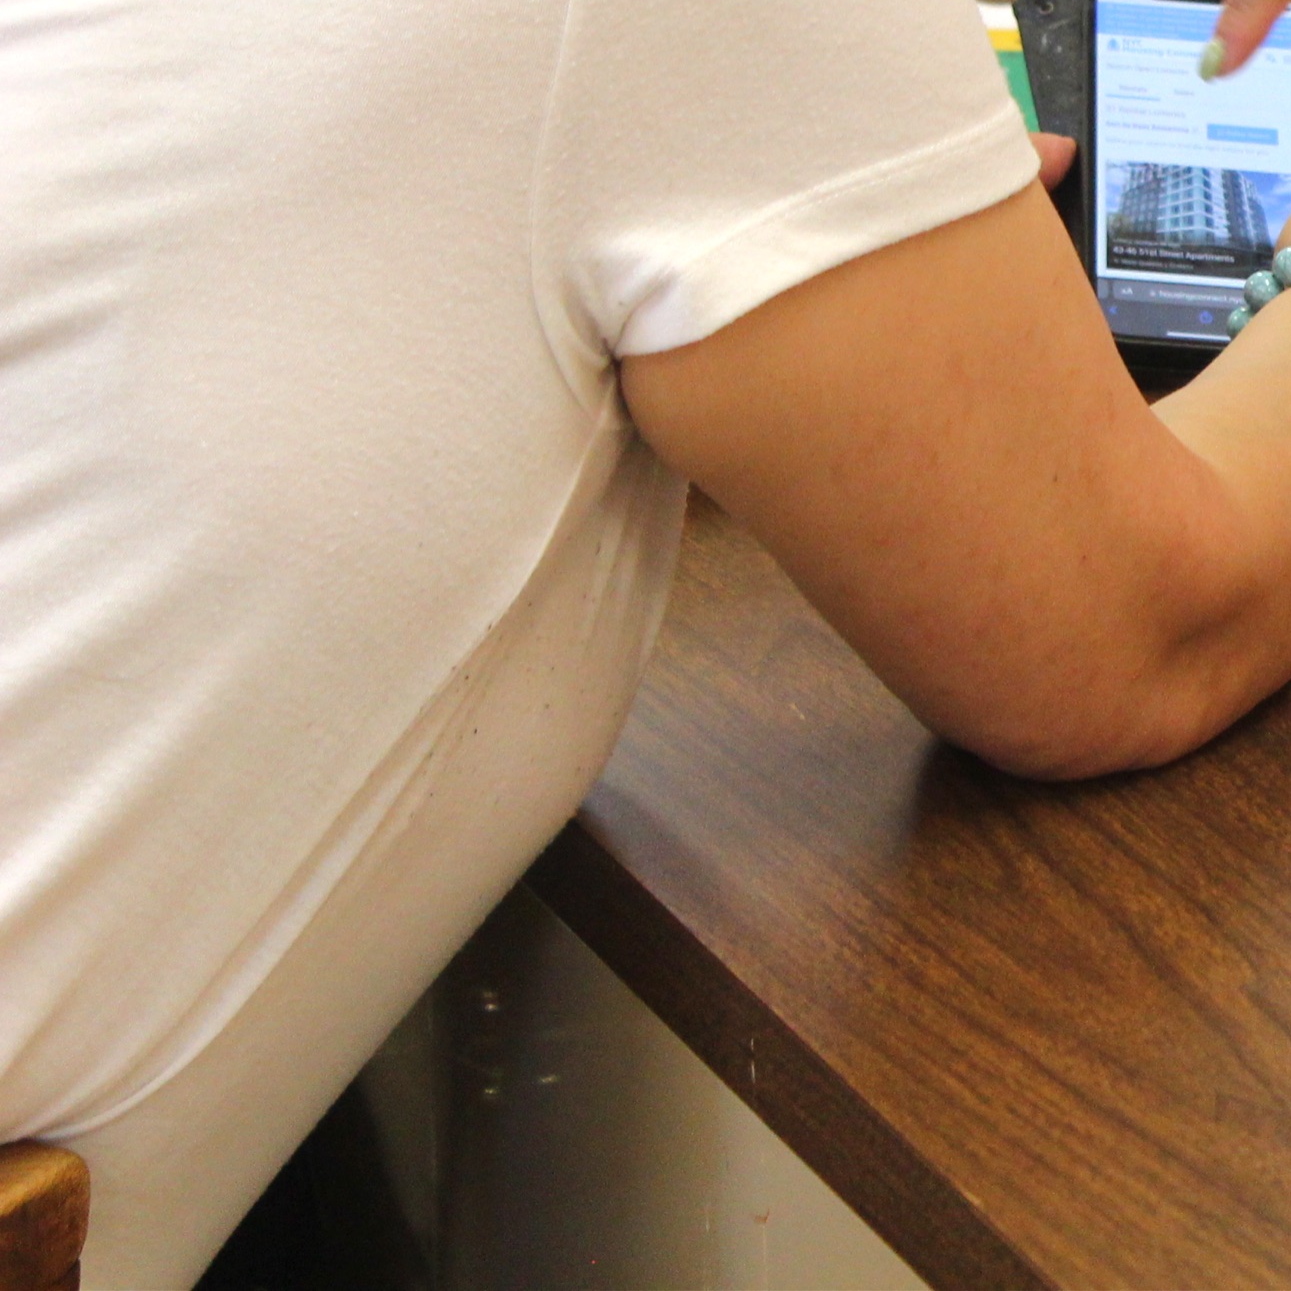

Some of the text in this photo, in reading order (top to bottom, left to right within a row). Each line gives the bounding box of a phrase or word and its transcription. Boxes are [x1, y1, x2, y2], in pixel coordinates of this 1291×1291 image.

[1122, 45, 1164, 57] Housing
[1158, 249, 1184, 259] Street
[1185, 252, 1235, 263] Apartments
